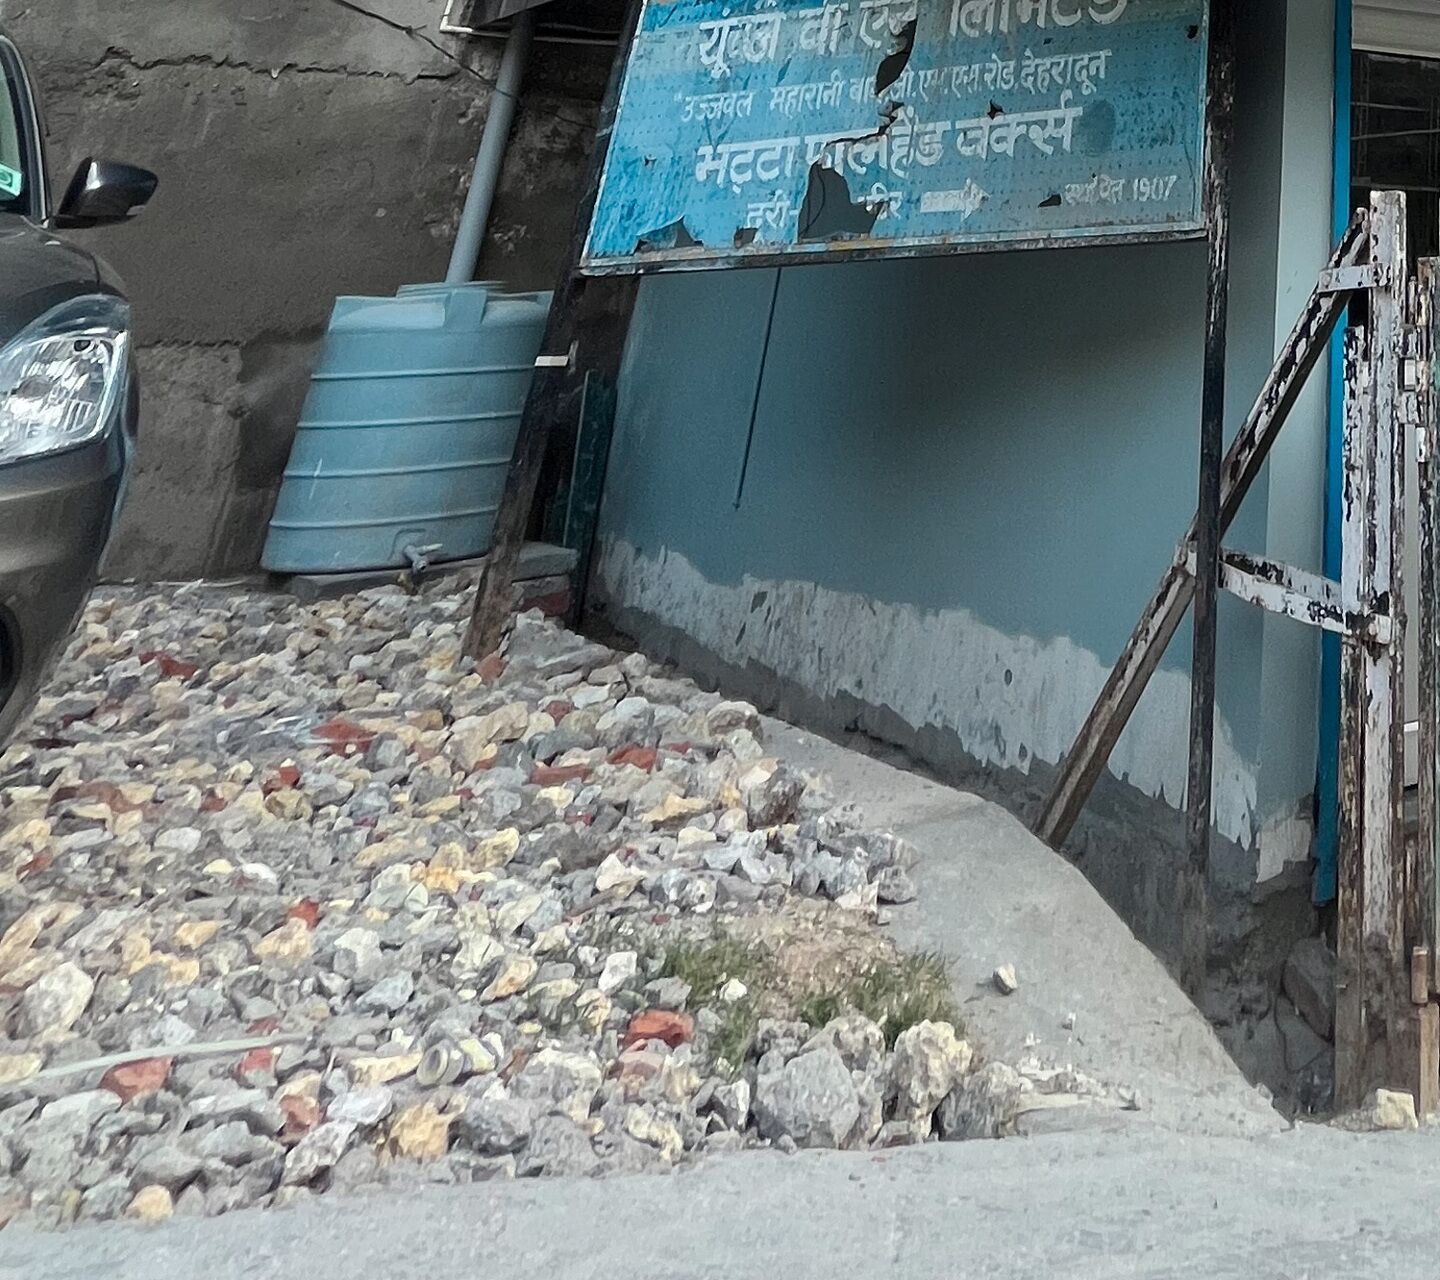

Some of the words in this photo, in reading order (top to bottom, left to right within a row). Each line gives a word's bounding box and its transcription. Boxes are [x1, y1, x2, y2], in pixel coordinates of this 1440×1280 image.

[769, 69, 846, 119] महारानी
[695, 137, 800, 194] भट्टा
[1132, 175, 1178, 202] 1907
